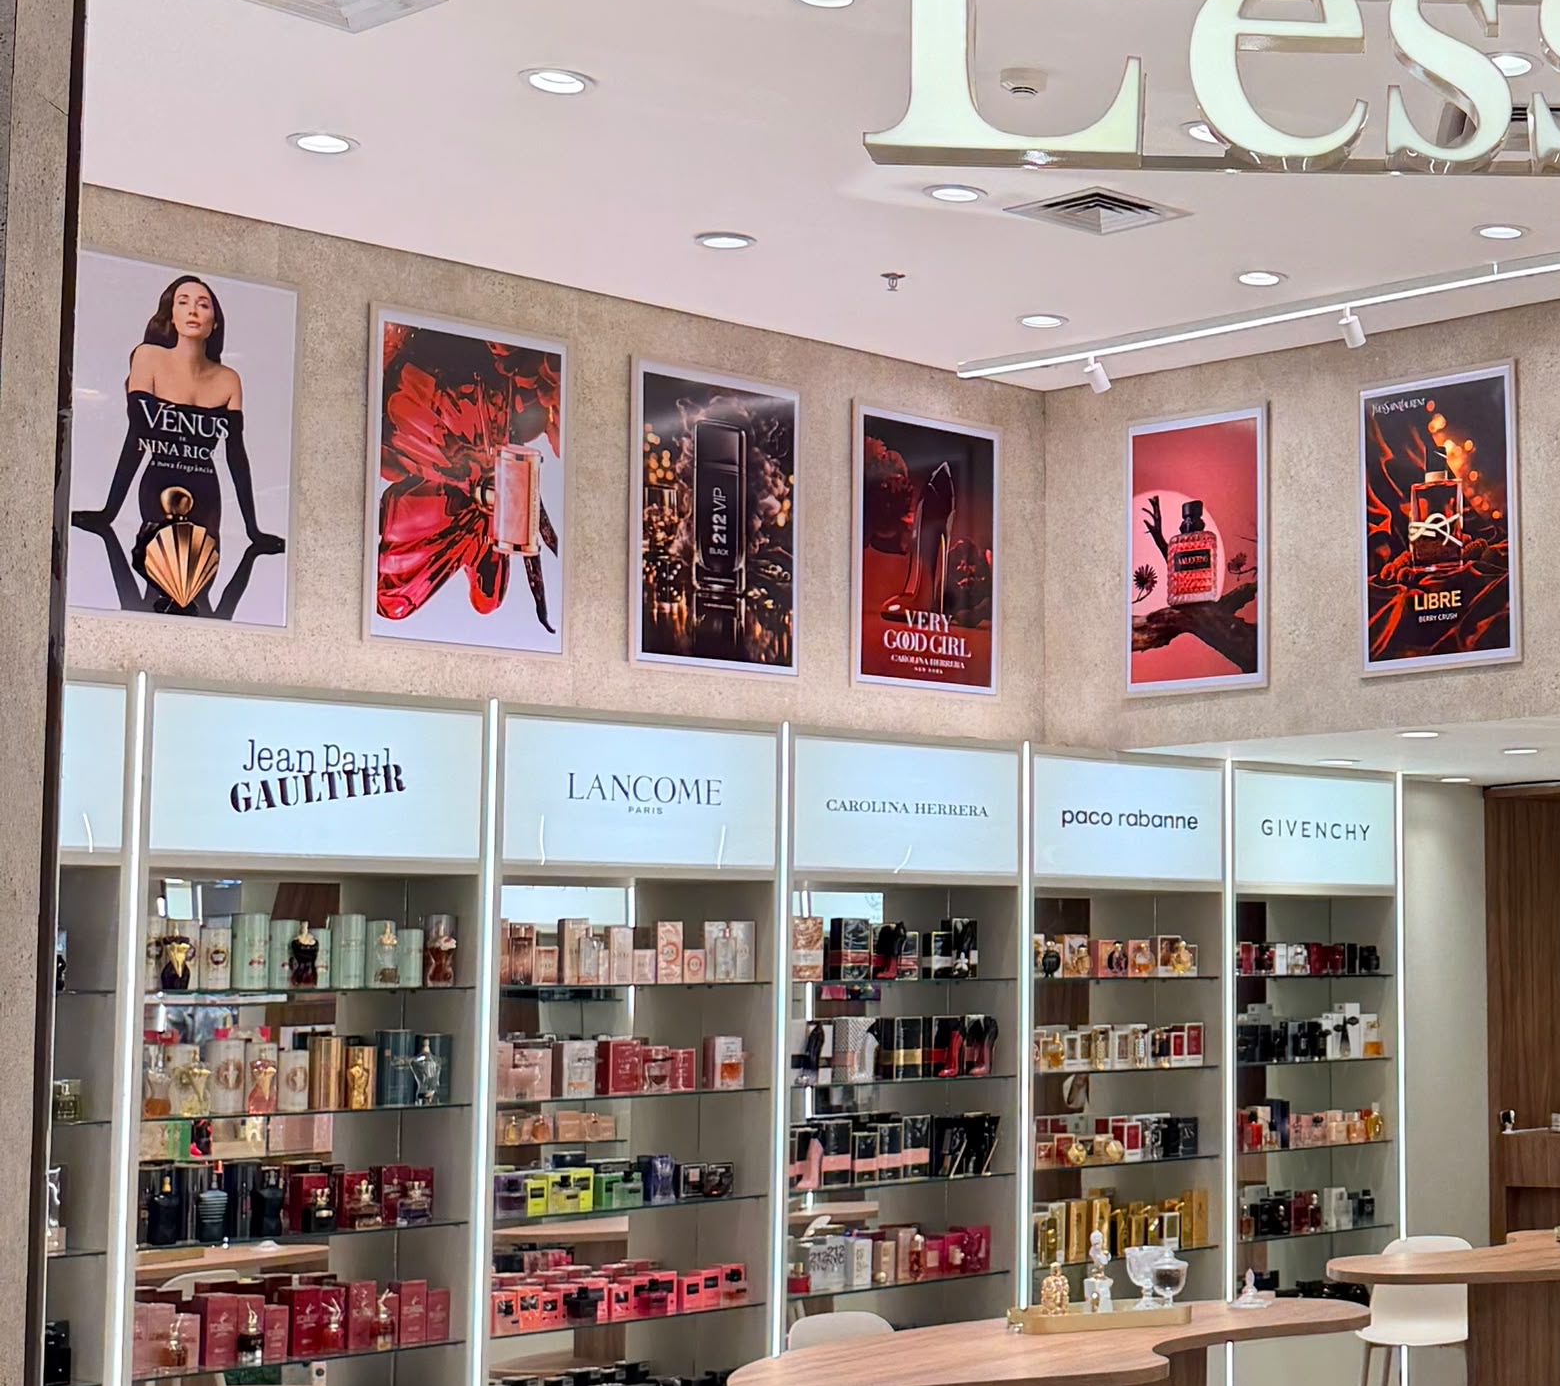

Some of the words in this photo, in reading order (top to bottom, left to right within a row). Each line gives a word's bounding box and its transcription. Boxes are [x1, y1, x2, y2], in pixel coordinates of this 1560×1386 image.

[138, 399, 229, 439] VÉNUS
[138, 438, 180, 457] NINA
[712, 487, 727, 512] VIP
[712, 514, 727, 545] 212
[1414, 590, 1462, 611] LIBRE
[905, 609, 953, 633] VERY
[884, 629, 928, 653] GOOD
[930, 634, 972, 658] GIRL
[243, 739, 317, 775] Jean
[323, 743, 391, 776] Paul
[230, 764, 406, 813] GAULTIER
[567, 772, 722, 806] LANCOME
[628, 806, 663, 815] PARIS
[826, 799, 910, 814] CAROLINA
[915, 802, 989, 818] HERRERA
[1061, 809, 1113, 828] paco
[1118, 809, 1199, 830] rabanne
[1261, 819, 1370, 841] GIVENCHY
